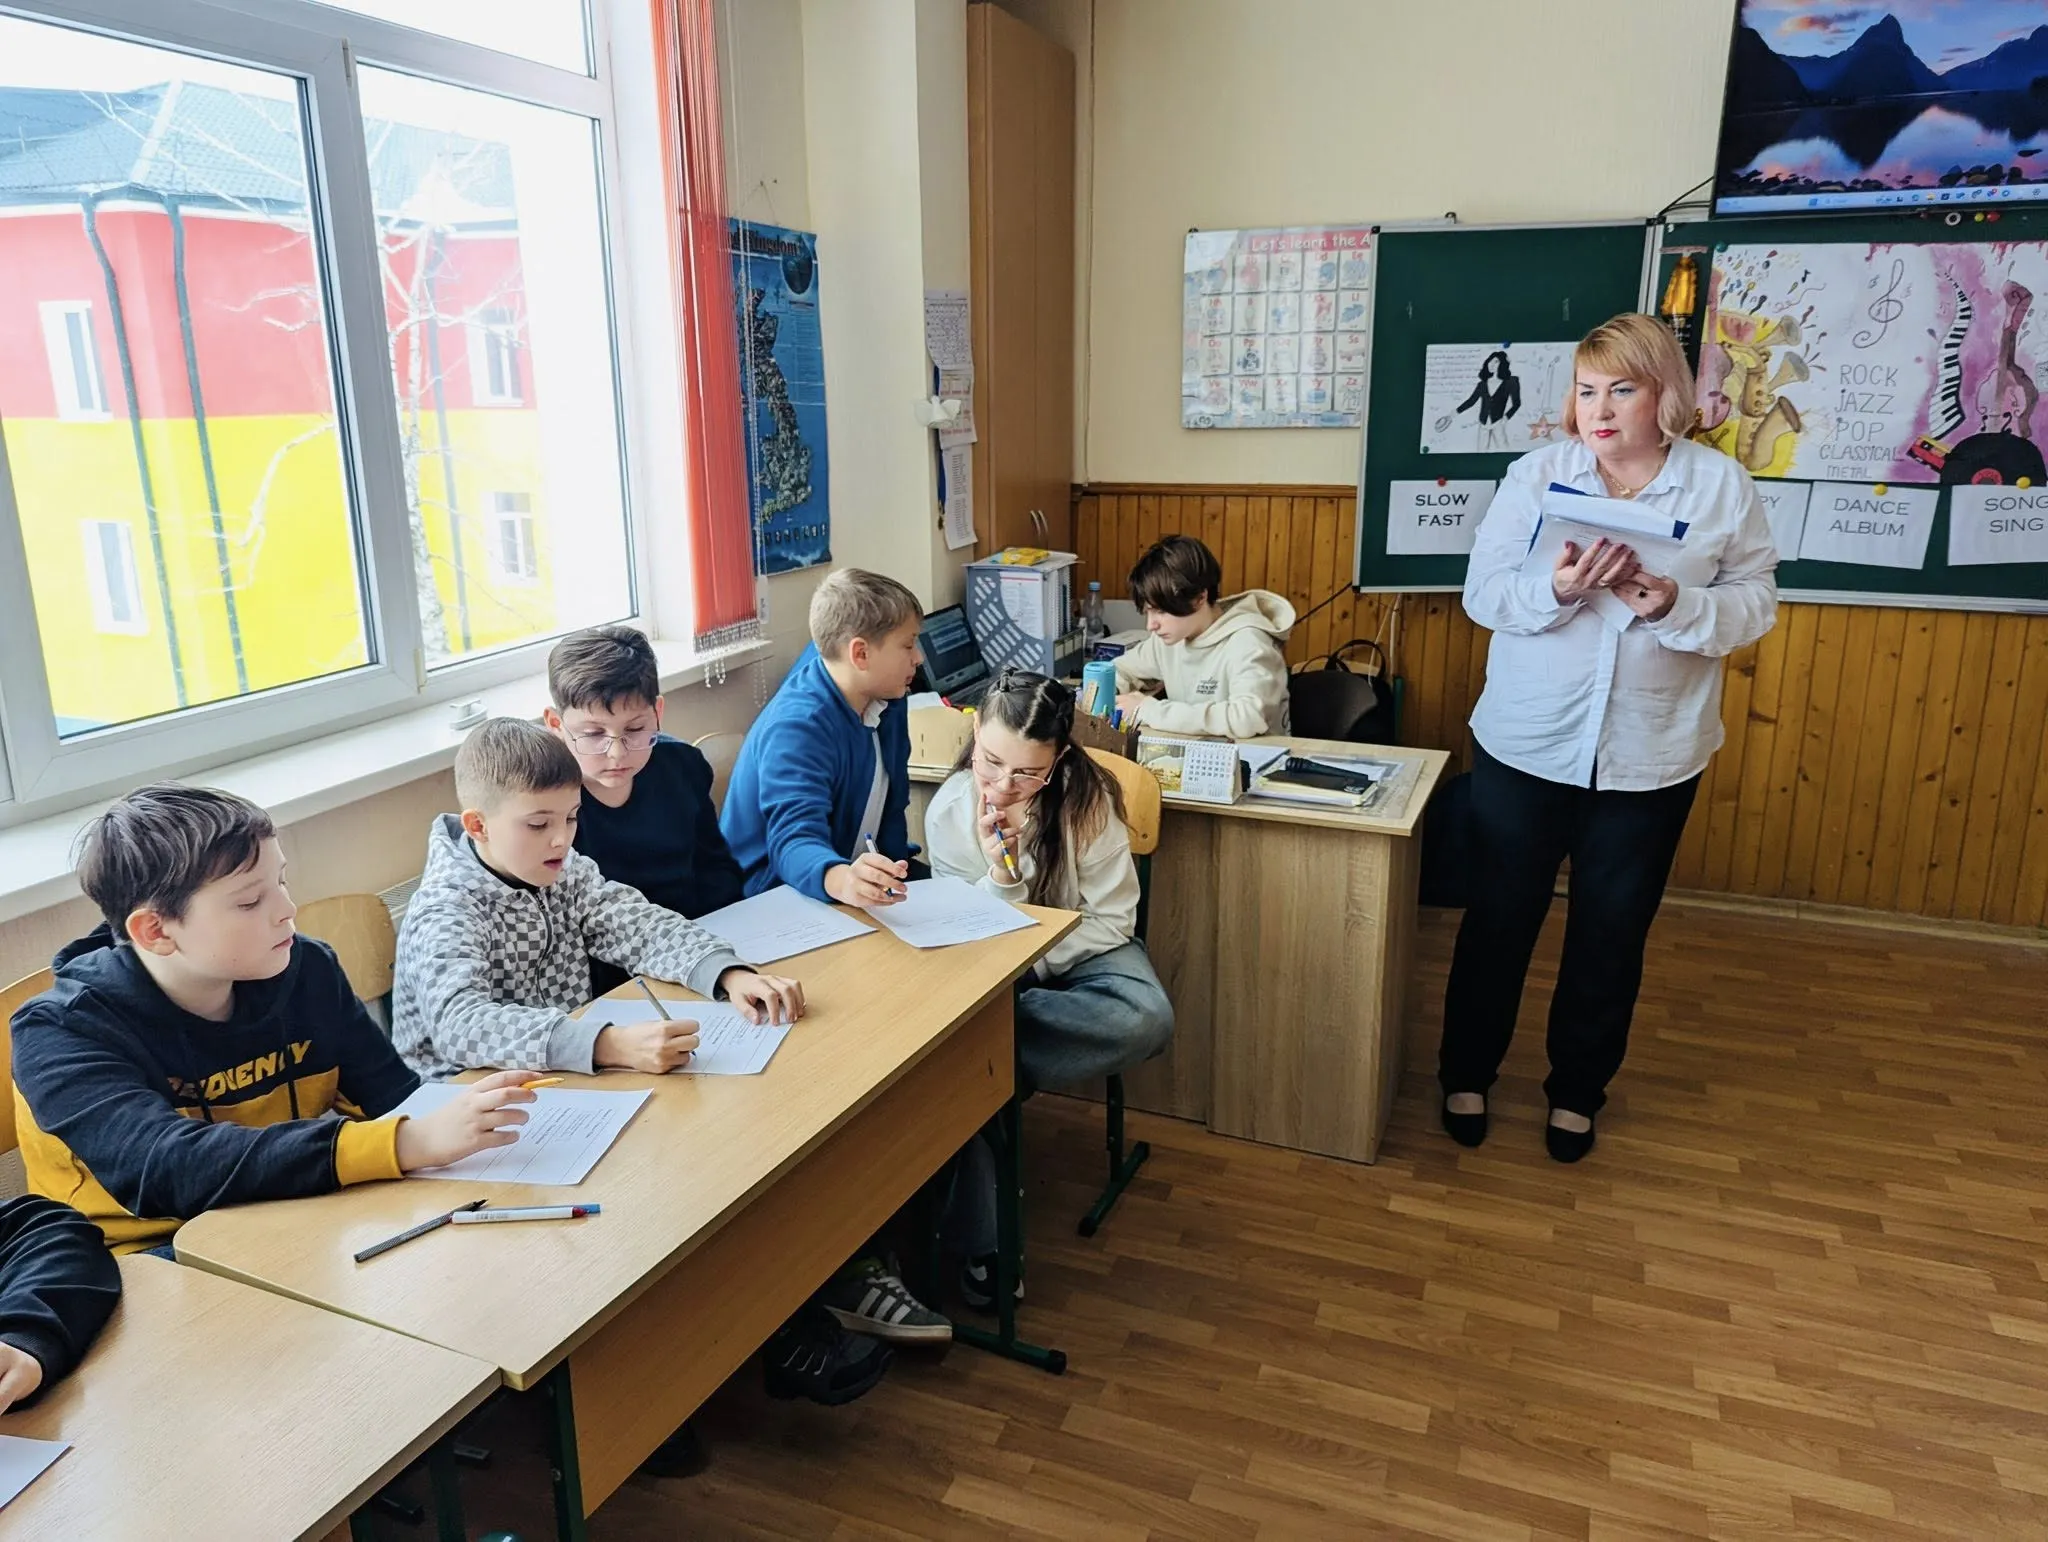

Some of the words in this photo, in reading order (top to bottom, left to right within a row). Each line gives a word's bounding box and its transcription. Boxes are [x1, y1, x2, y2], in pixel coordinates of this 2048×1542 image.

[1251, 237, 1285, 251] Let's
[1290, 235, 1327, 249] learn
[1333, 233, 1356, 246] the
[1840, 364, 1898, 387] ROCK
[1834, 420, 1885, 442] POP
[1415, 493, 1470, 506] SLOW
[1833, 498, 1911, 516] DANCE
[1984, 495, 2048, 511] SONG
[1417, 514, 1465, 527] FAST
[1829, 519, 1905, 537] ALBUM
[1989, 517, 2044, 533] SING
